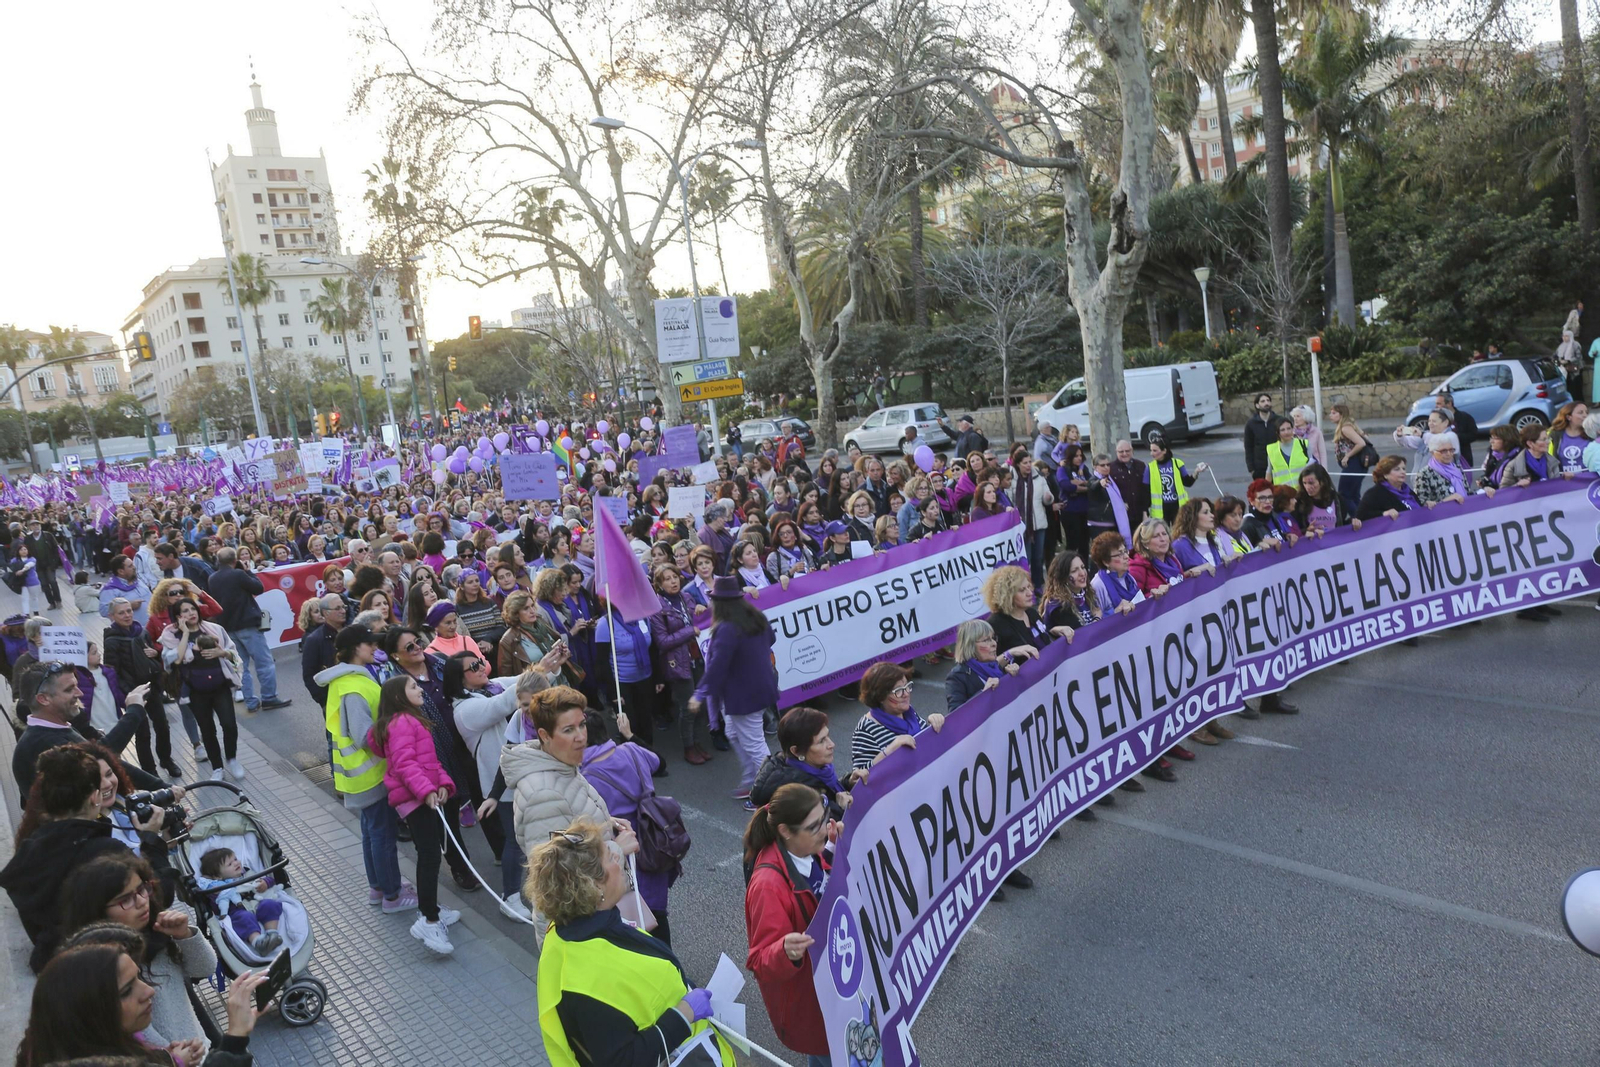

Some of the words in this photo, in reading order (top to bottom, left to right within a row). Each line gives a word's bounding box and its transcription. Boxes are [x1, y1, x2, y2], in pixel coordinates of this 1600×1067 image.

[695, 365, 704, 380] P
[707, 369, 725, 377] PLAZA
[874, 578, 909, 607] ES
[910, 539, 1017, 594] FEMINISTA
[879, 607, 920, 644] 8M
[801, 670, 844, 692] MOVIMIENTO
[845, 656, 878, 676] FEMINISTA
[884, 640, 920, 660] ASOCIATIVO
[922, 637, 931, 646] DE
[863, 827, 919, 958] UN
[910, 752, 997, 899] PASO
[1005, 672, 1090, 816] ATRÁS
[1092, 653, 1142, 740] EN
[1146, 622, 1198, 711] LOS
[1314, 562, 1354, 624] DE
[1354, 547, 1411, 610] LAS
[1414, 510, 1575, 594] MUJERES
[1006, 739, 1137, 861] FEMINISTA
[1138, 724, 1156, 757] Y
[1285, 642, 1307, 675] DE
[1309, 609, 1406, 663] MUJERES
[1410, 598, 1447, 628] DE
[1450, 566, 1590, 618] MÁLAGA
